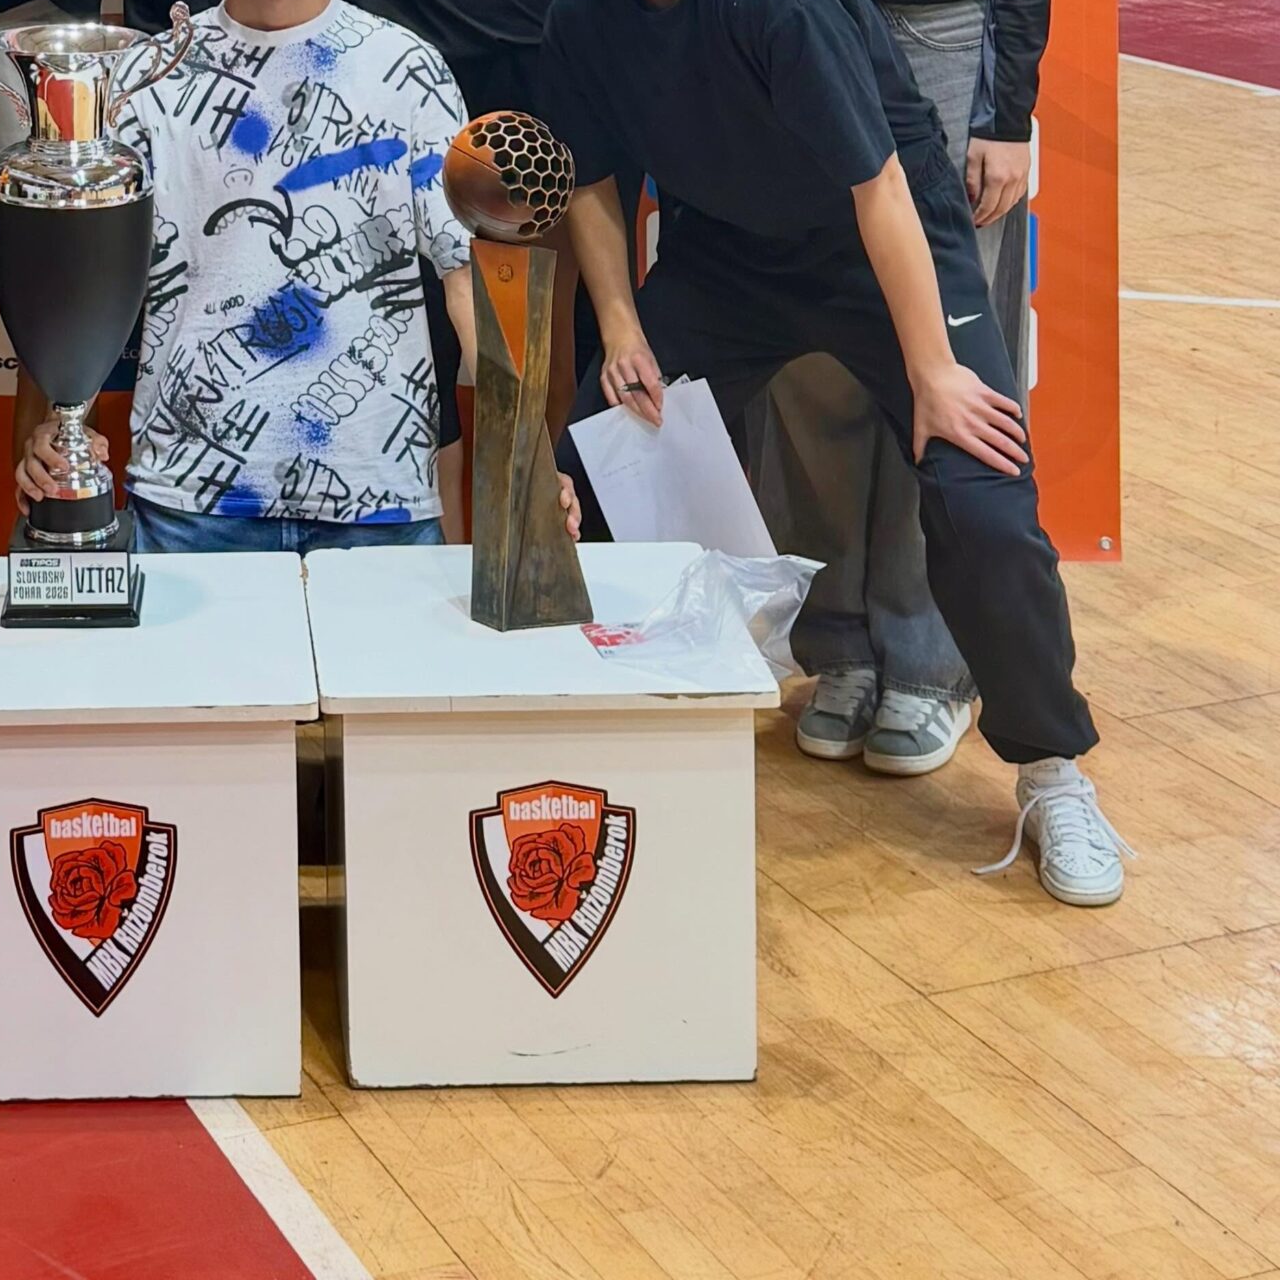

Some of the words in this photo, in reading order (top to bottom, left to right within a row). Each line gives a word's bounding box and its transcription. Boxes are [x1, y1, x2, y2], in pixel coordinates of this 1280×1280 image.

[50, 811, 137, 839] basketbal
[509, 793, 596, 821] basketbal
[86, 937, 132, 992] MBK
[543, 919, 590, 973] MBK
